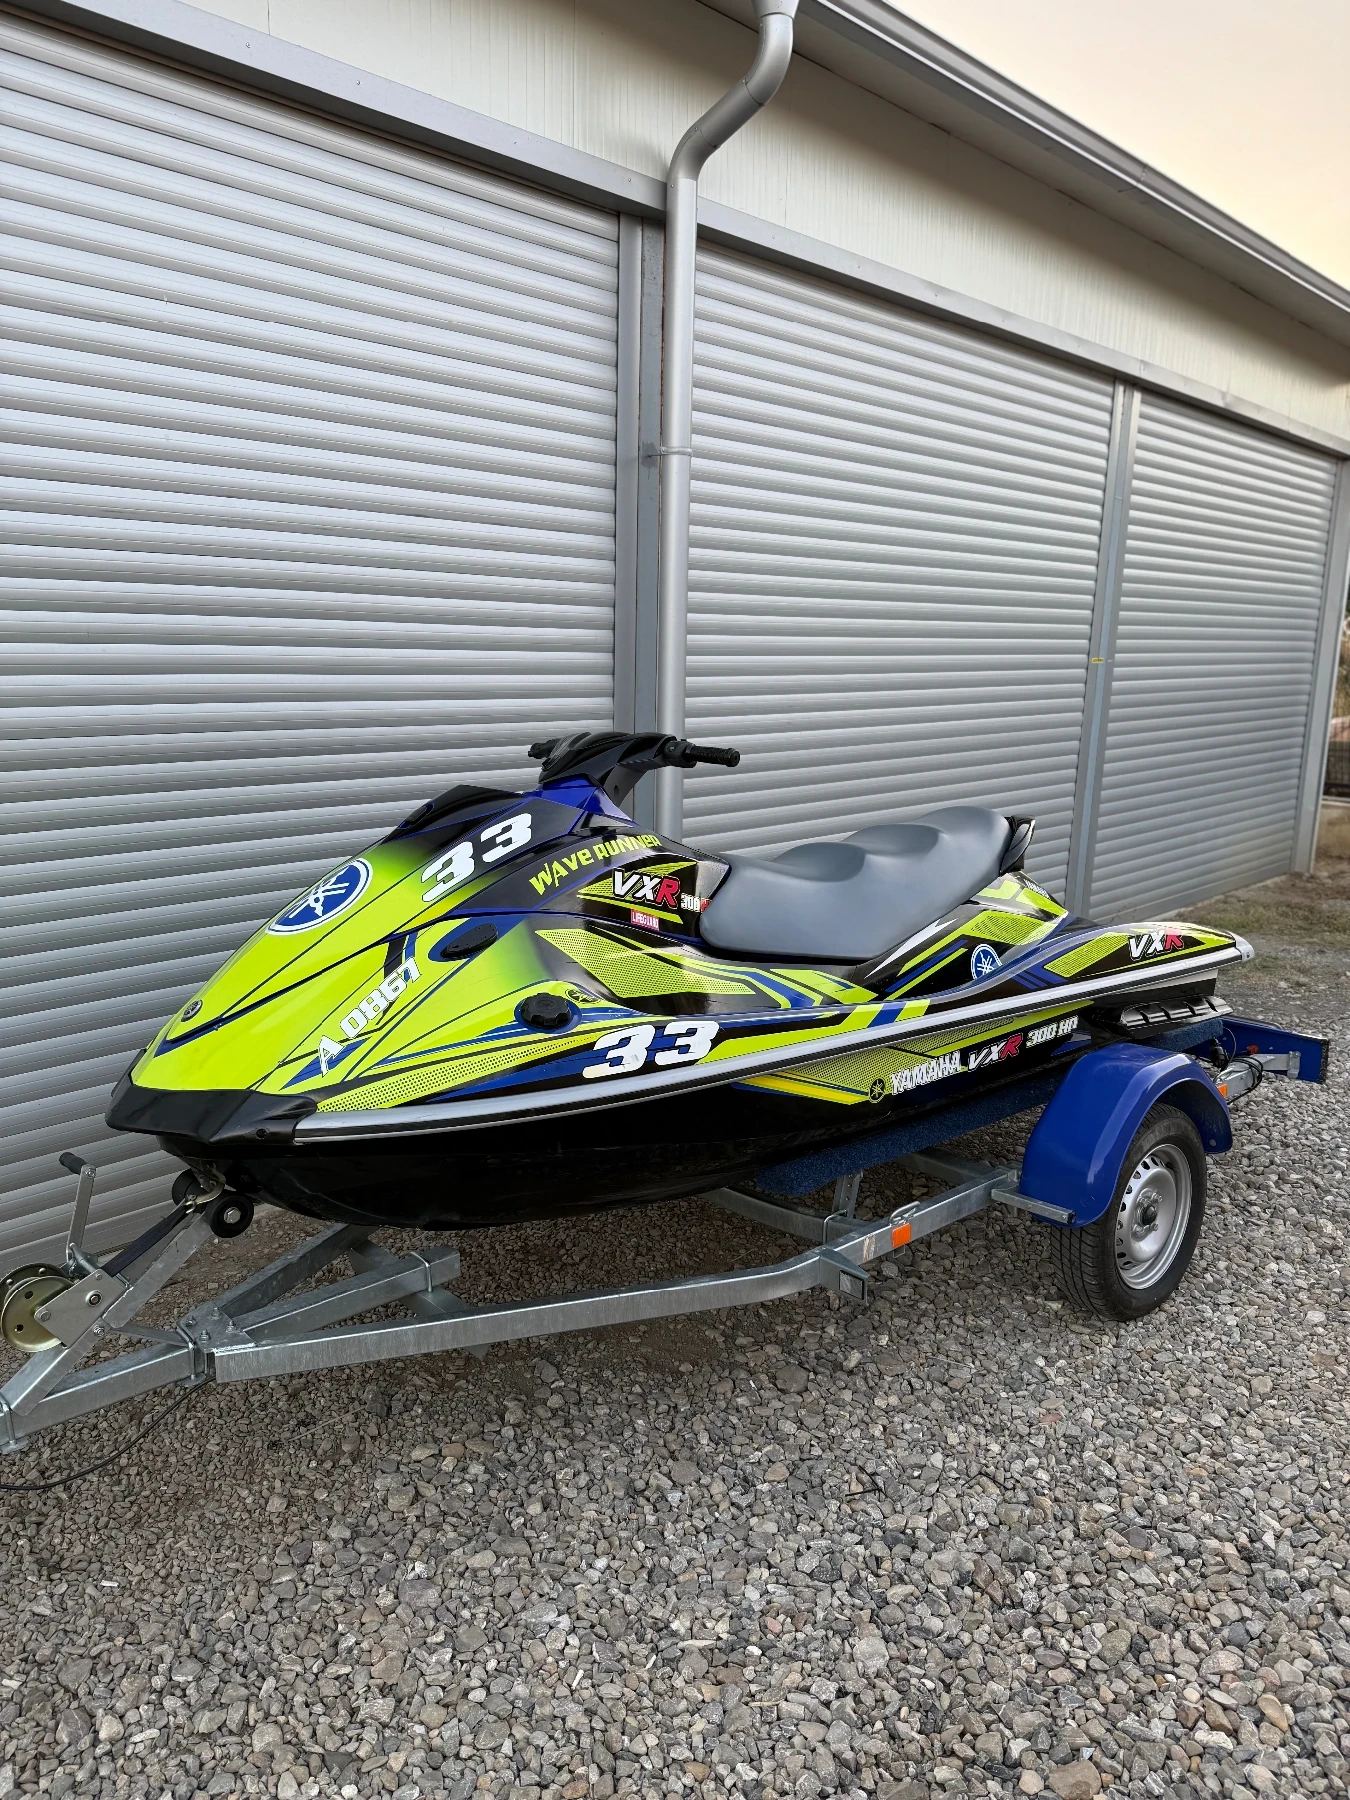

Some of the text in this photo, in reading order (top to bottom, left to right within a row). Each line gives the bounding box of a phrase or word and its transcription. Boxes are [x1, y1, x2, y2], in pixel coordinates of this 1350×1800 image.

[421, 813, 532, 902] 33
[613, 869, 680, 908] VXR
[681, 893, 700, 912] 300
[1129, 928, 1184, 960] VXR
[319, 956, 421, 1078] A 0867
[582, 1020, 721, 1079] 33
[891, 1050, 961, 1095] YAMAHA
[968, 1033, 1024, 1072] VXR
[1026, 1022, 1058, 1048] 300
